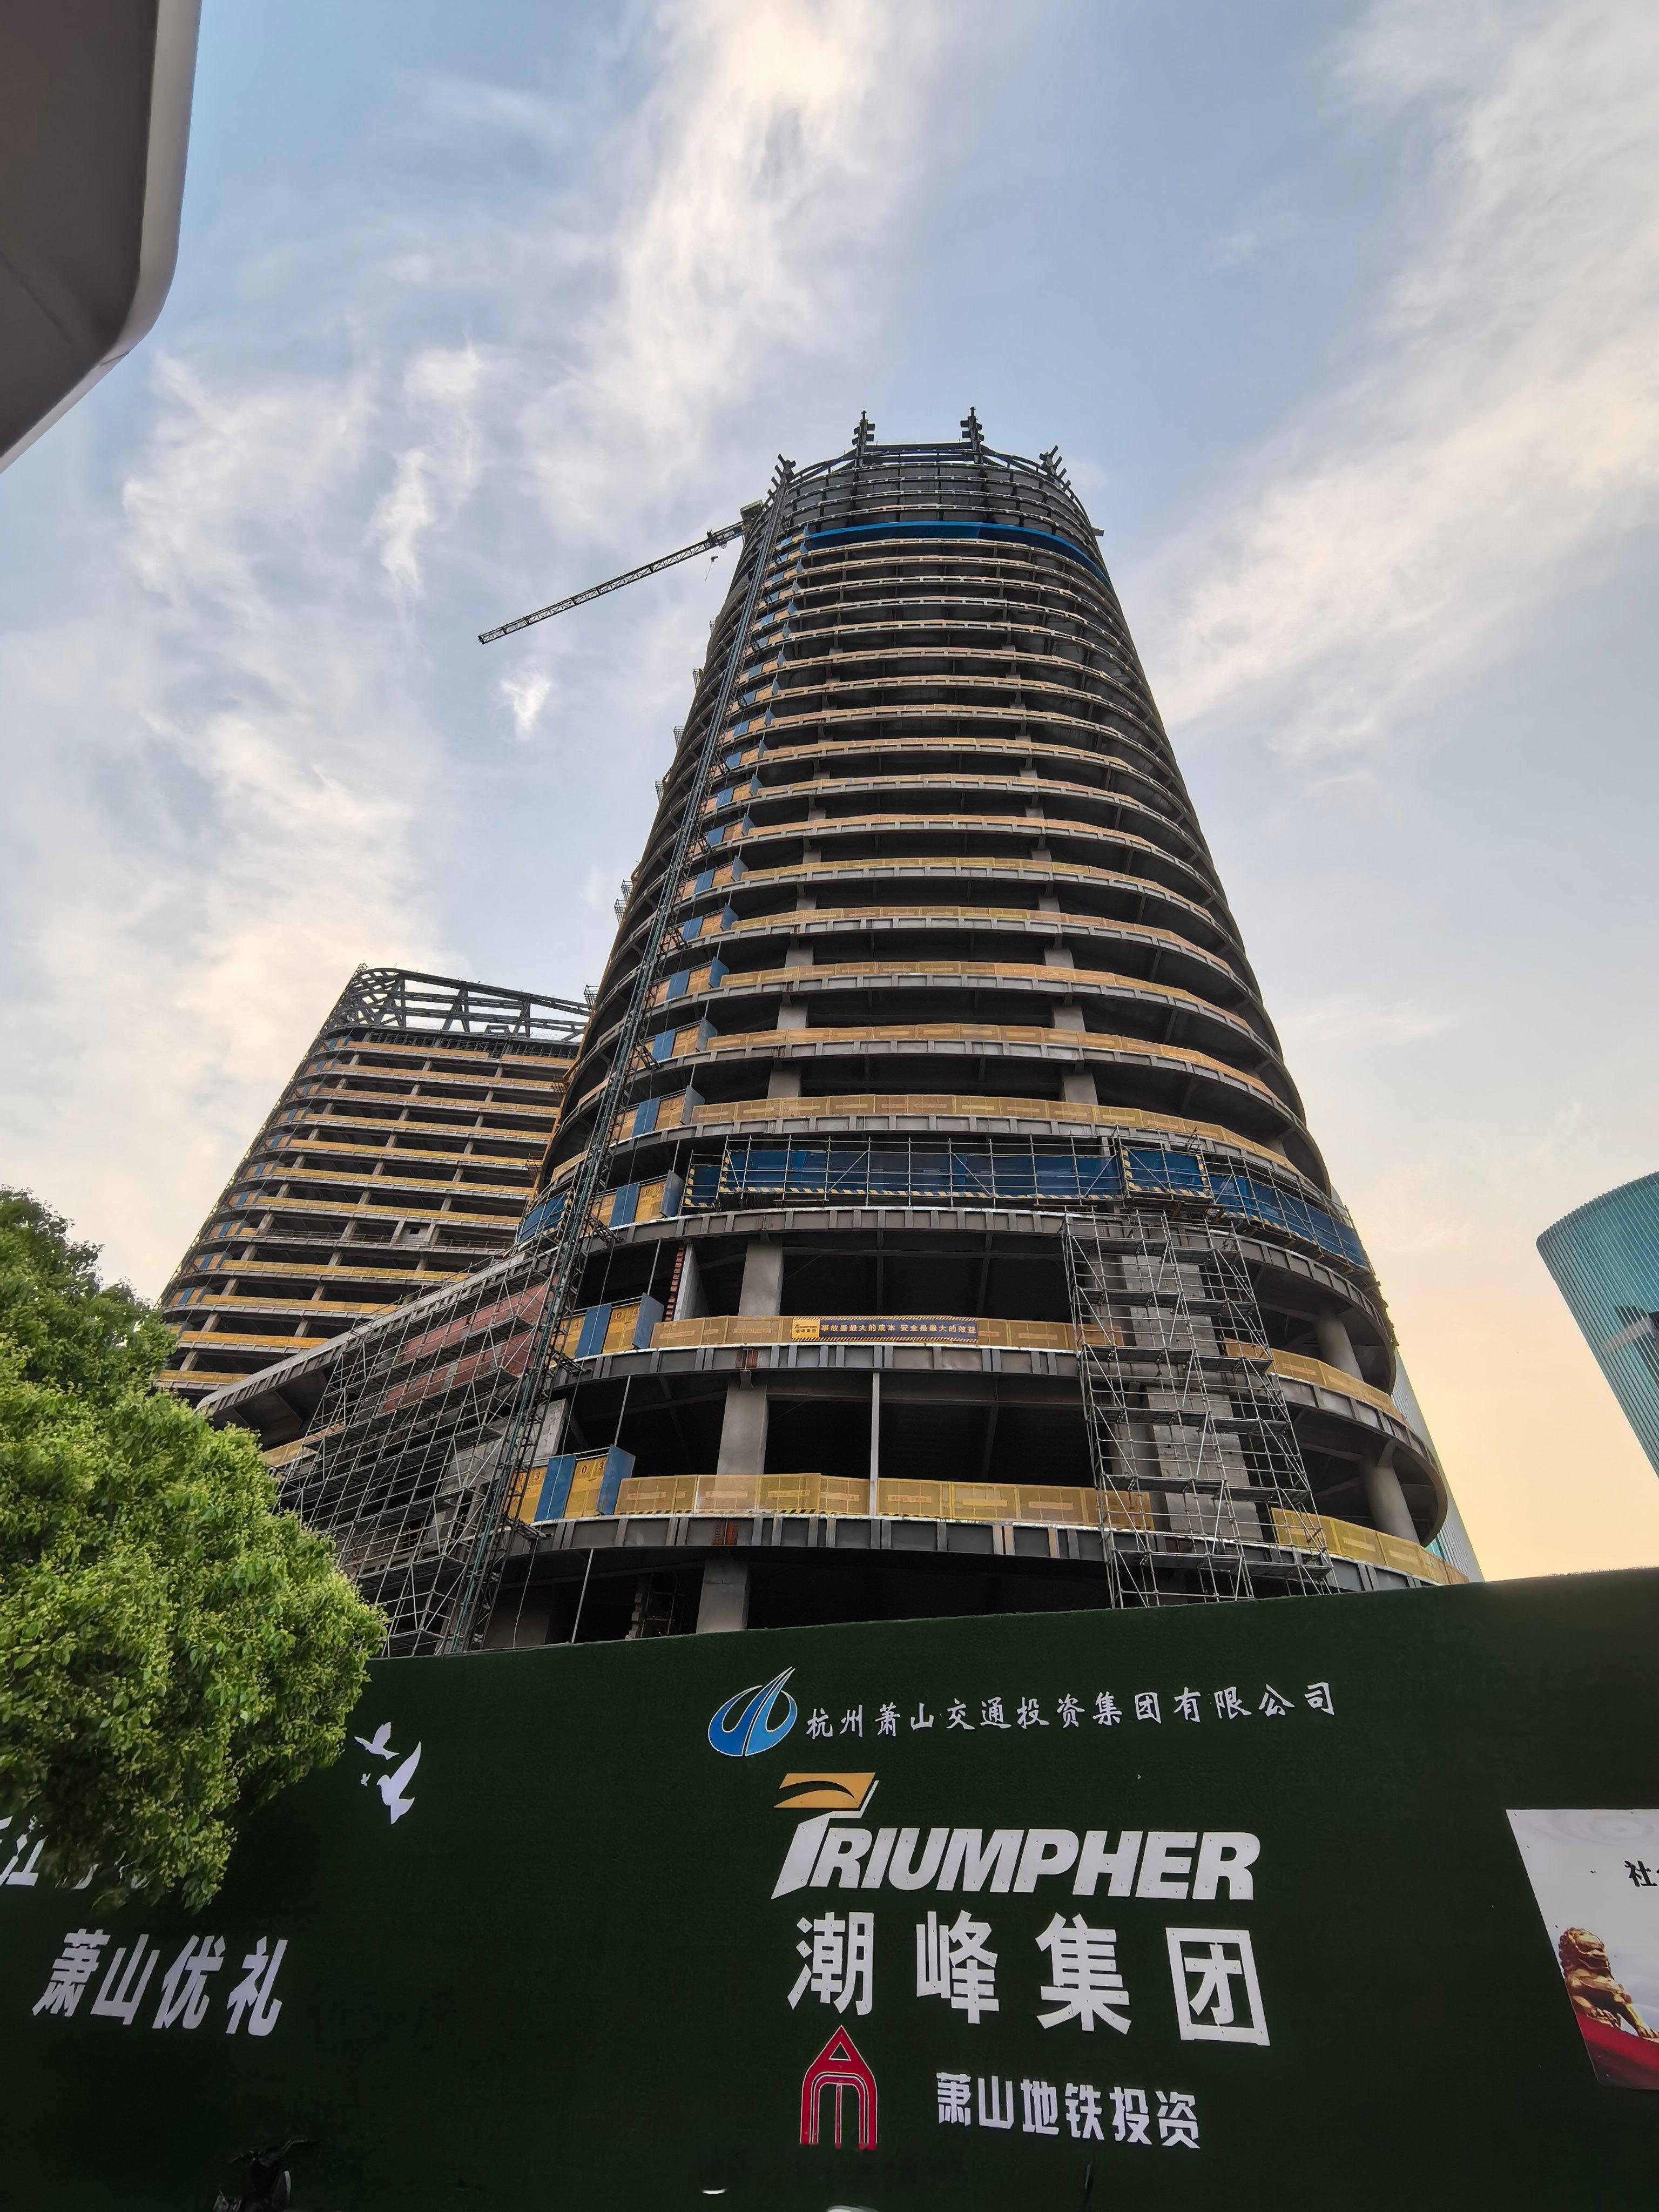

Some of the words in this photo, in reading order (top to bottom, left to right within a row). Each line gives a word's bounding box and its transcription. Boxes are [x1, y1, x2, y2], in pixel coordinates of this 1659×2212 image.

[821, 1324, 895, 1332] 事故是最大的成本
[900, 1324, 976, 1334] 安全是最大的效益
[806, 1682, 1335, 1740] 杭州萧山交通投资集团有限公司
[771, 1772, 1261, 1900] TRIUMPHER
[1624, 1860, 1659, 1887] 社
[32, 1928, 288, 2036] 萧山优礼
[787, 1909, 1271, 2047] 潮峰集团
[936, 2072, 1201, 2149] 萧山地铁投资
